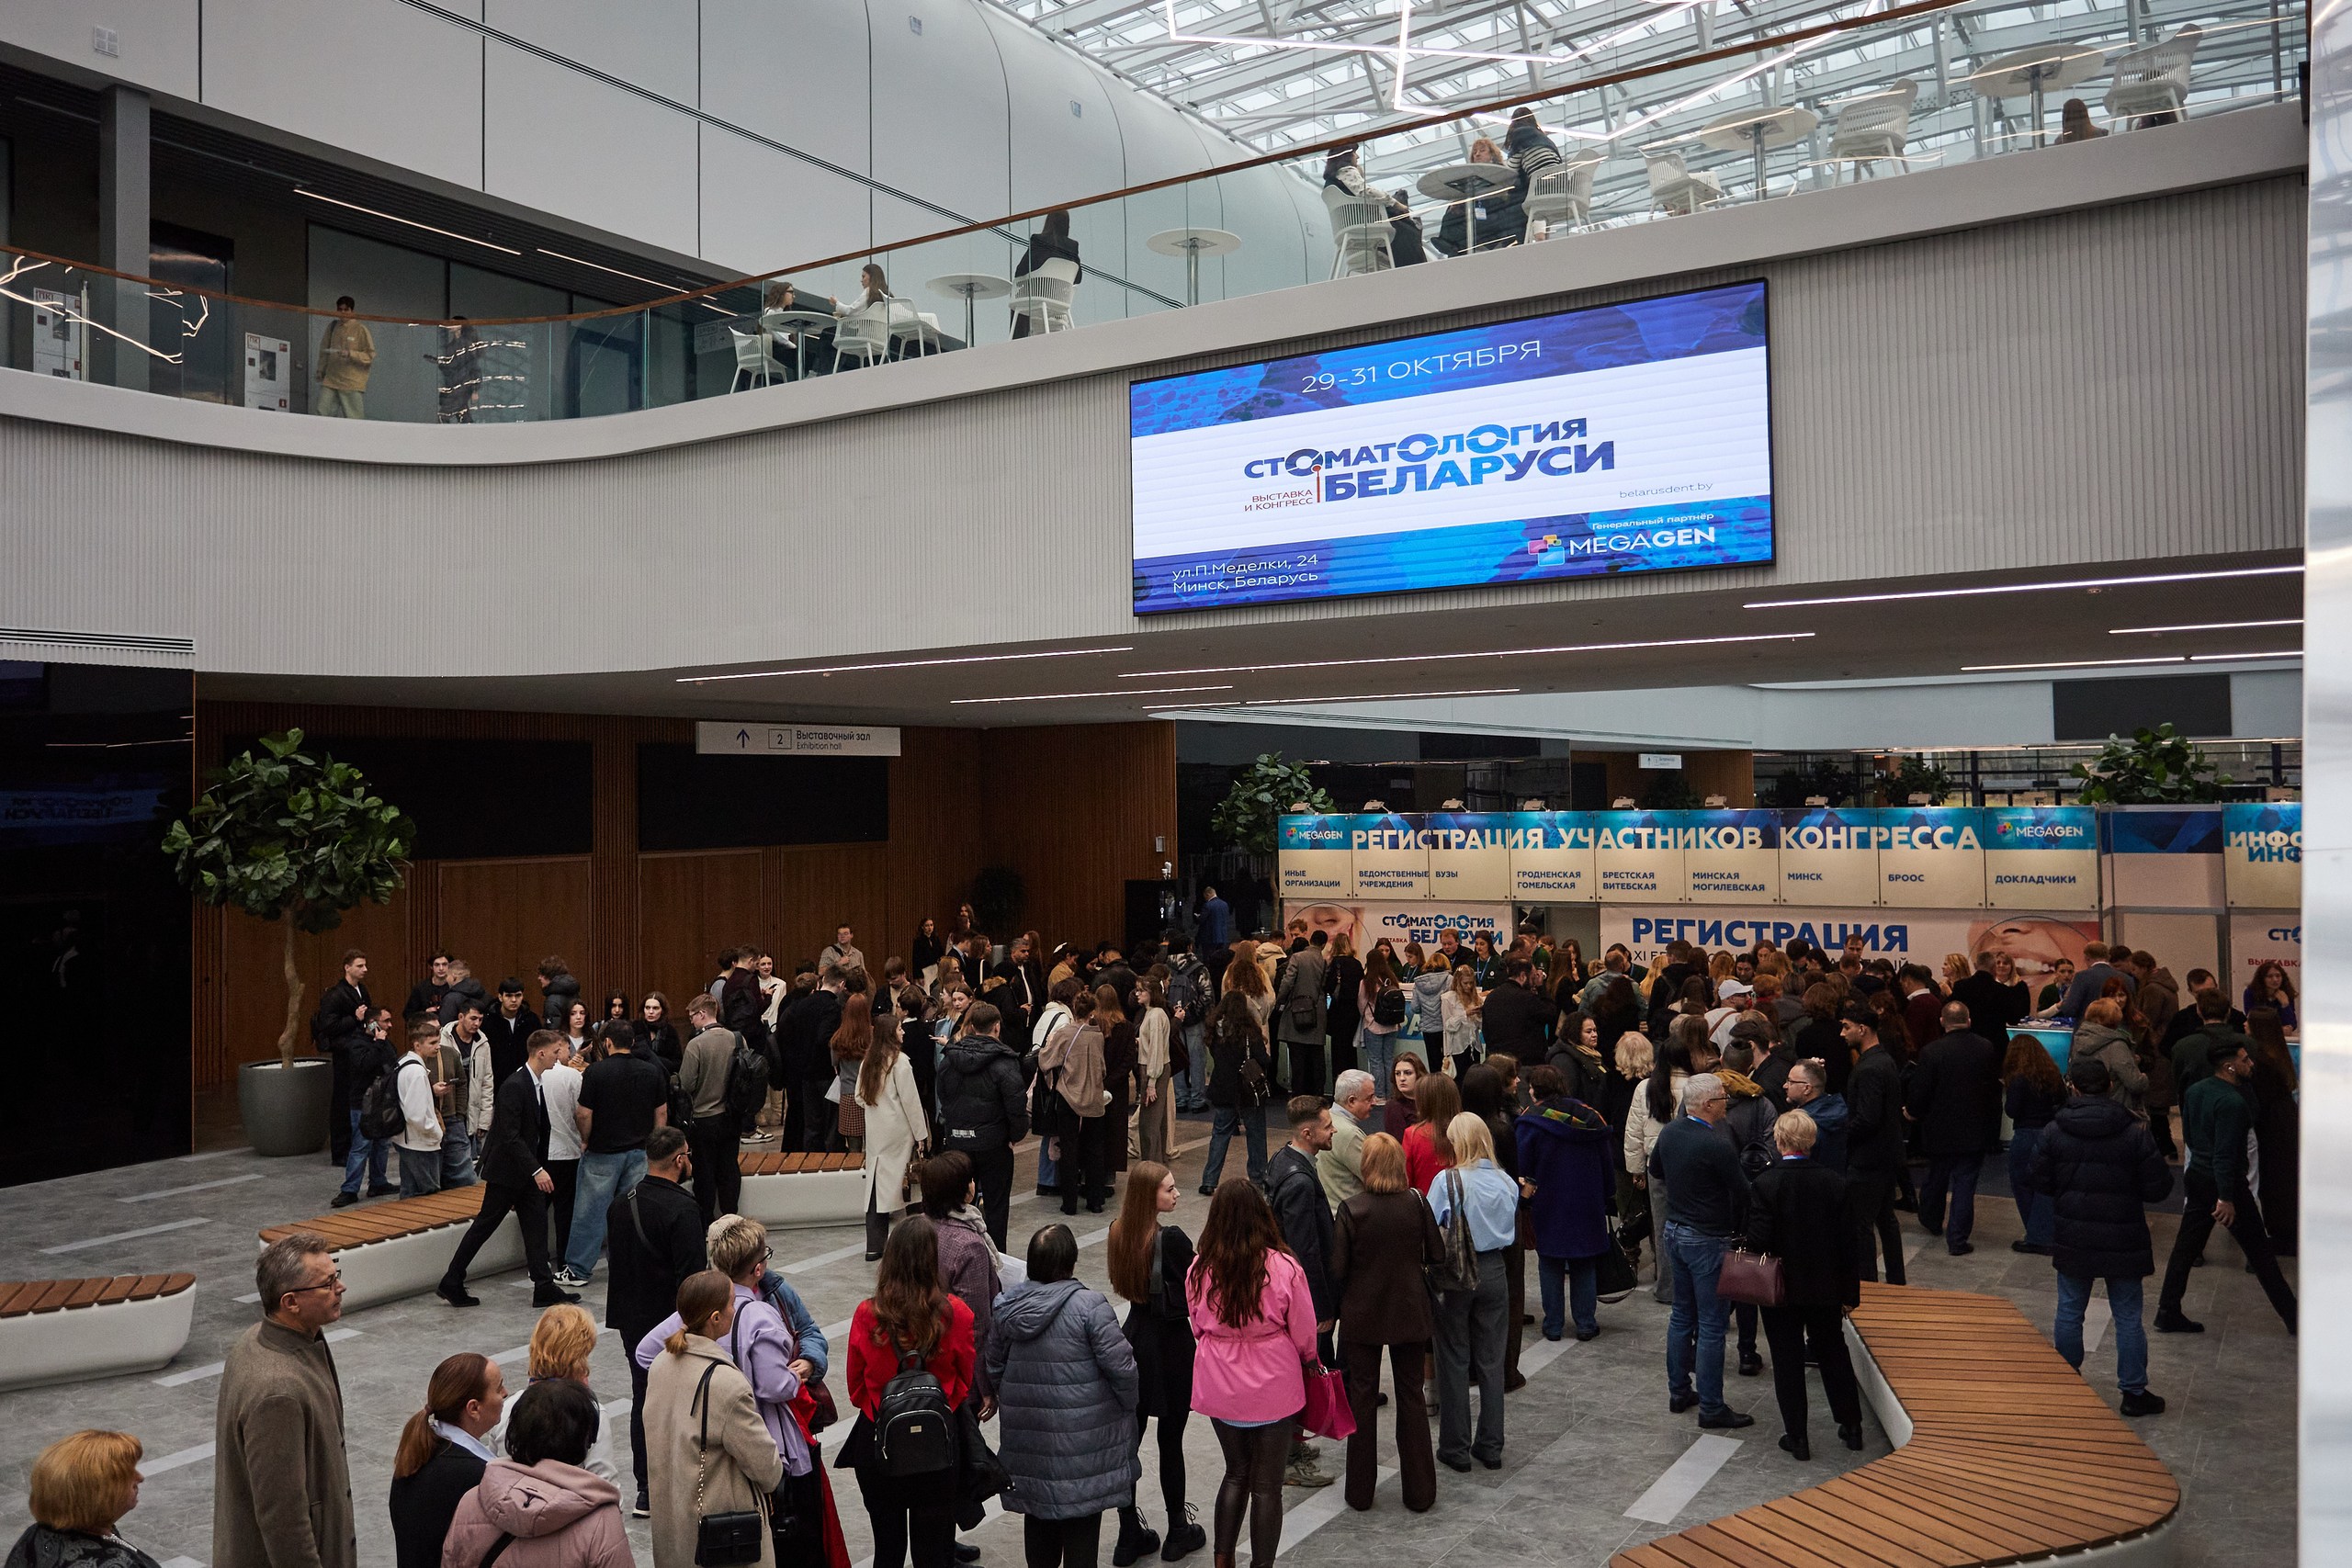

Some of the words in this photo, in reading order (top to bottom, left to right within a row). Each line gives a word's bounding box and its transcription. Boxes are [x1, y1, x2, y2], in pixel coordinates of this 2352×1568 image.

[1302, 367, 1377, 394] 29-31
[1387, 340, 1542, 381] ОКТЯБРЯ
[1244, 418, 1588, 479] СТОМАТОЛОГИЯ
[1326, 441, 1615, 502] БЕЛАРУСИ
[1251, 489, 1314, 503] ВЫСТАВКА
[1619, 482, 1713, 499] belarusdent.by
[1256, 497, 1314, 511] КОНГРЕСС
[1592, 516, 1664, 531] Генеральный
[1667, 513, 1714, 524] партнёр
[1569, 526, 1715, 556] MEGAGEN
[1172, 559, 1292, 581] ул.П.Меделки,
[1296, 554, 1318, 568] 24
[1173, 581, 1229, 593] Минск,
[1235, 571, 1318, 588] Беларусь
[777, 733, 784, 745] 2
[797, 730, 854, 740] Выставочный
[797, 741, 829, 750] Exhibition
[1298, 830, 1343, 840] MEGAGEN
[2016, 826, 2084, 838] MEGAGEN
[1352, 829, 1544, 850] РЕГИСТРАЦИЯ
[1560, 827, 1762, 850] УЧАСТНИКОВ
[1781, 826, 1982, 850] КОНГРЕССА
[1359, 870, 1430, 878] ВЕДОМСТВЕННЫЕ
[1517, 870, 1582, 879] ГРОДНЕНСКАЯ
[1602, 871, 1656, 880] БРЕСТСКАЯ
[1692, 872, 1740, 880] МИНСКАЯ
[1787, 873, 1823, 881] МИНСК
[1888, 874, 1925, 883] БРООС
[1995, 874, 2076, 885] ДОКЛАДЧИКИ
[1284, 879, 1340, 888] ОРГАНИЗАЦИИ
[1359, 880, 1413, 889] УЧРЕЖДЕНИЯ
[1517, 881, 1577, 890] ГОМЕЛЬСКАЯ
[1602, 882, 1657, 891] ВИТЕБСКАЯ
[1692, 883, 1766, 892] МОГИЛЕВСКАЯ
[1382, 914, 1495, 929] СТОМАТОЛОГИЯ
[1411, 929, 1503, 945] БЕЛРУИ
[1633, 918, 1908, 953] РЕГИСТРАЦИЯ
[2247, 958, 2301, 967] ВЫАВК
